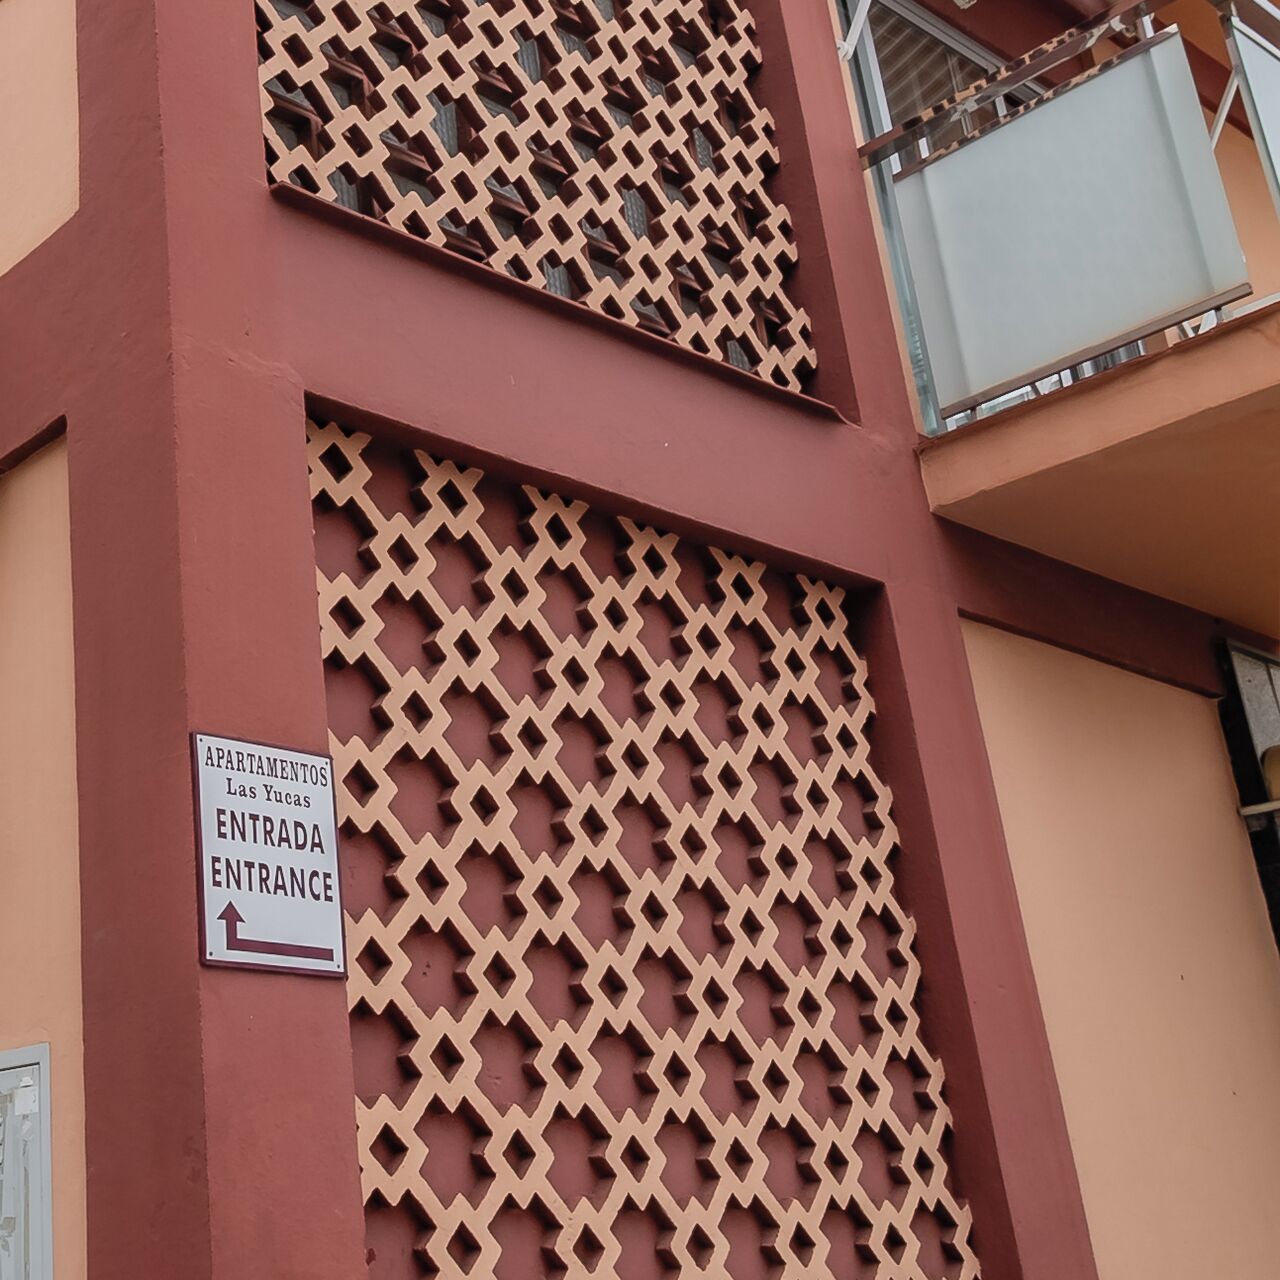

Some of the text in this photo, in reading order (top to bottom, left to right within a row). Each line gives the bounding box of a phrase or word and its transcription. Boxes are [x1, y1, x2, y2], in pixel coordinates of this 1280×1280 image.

[205, 746, 328, 787] APARTAMENTOS
[226, 778, 311, 808] Las Yucas
[216, 808, 325, 854] ENTRADA
[211, 855, 333, 903] ENTRANCE
